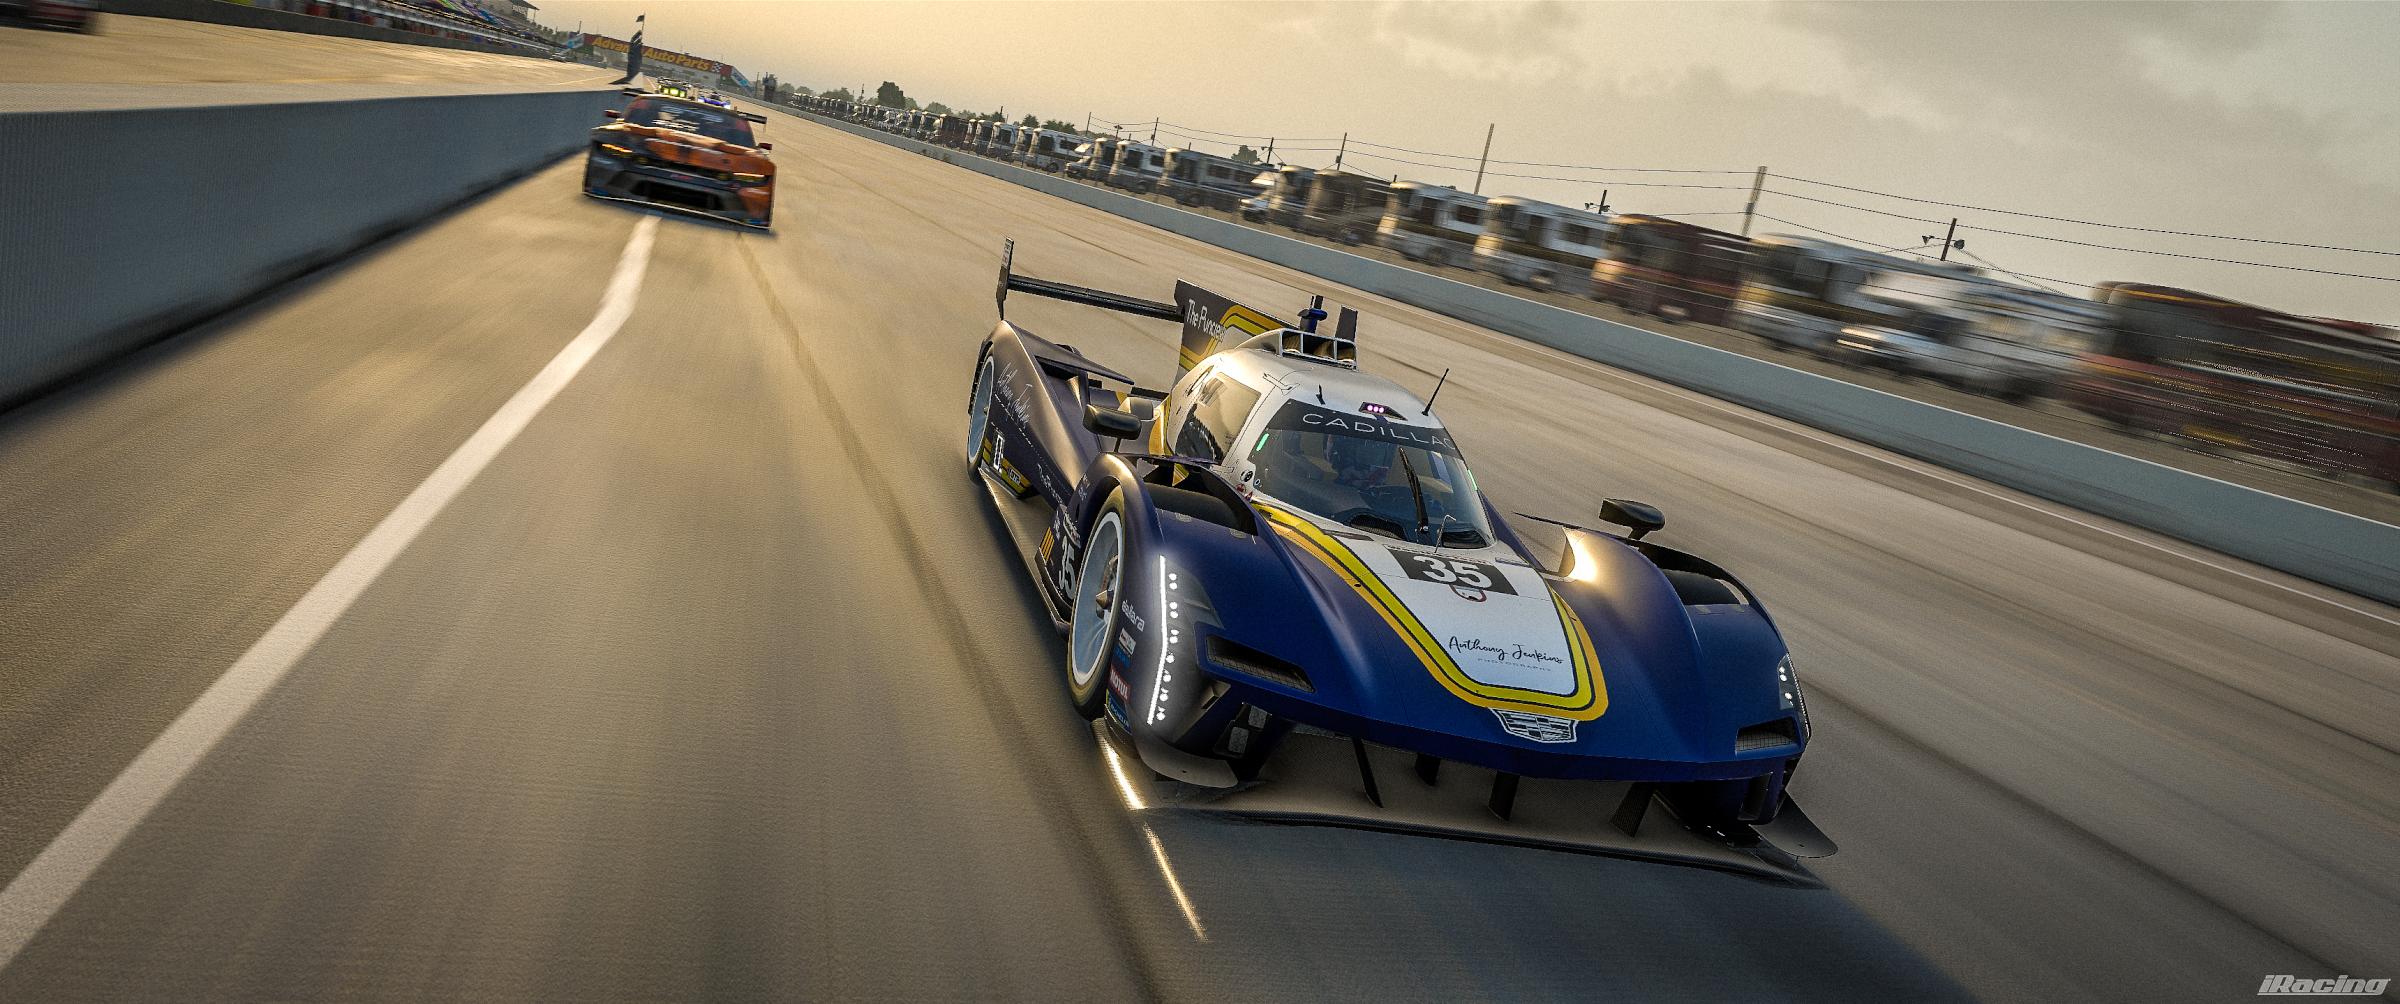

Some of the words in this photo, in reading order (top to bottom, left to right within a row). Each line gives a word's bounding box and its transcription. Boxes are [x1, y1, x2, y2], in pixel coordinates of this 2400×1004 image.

[592, 36, 629, 52] Advan
[644, 48, 675, 63] Auto
[676, 55, 712, 71] Parts
[1186, 298, 1199, 328] The
[1057, 535, 1077, 600] 35
[1413, 555, 1492, 588] 35
[1449, 636, 1508, 661] Anthony
[1512, 644, 1564, 664] Jenkins
